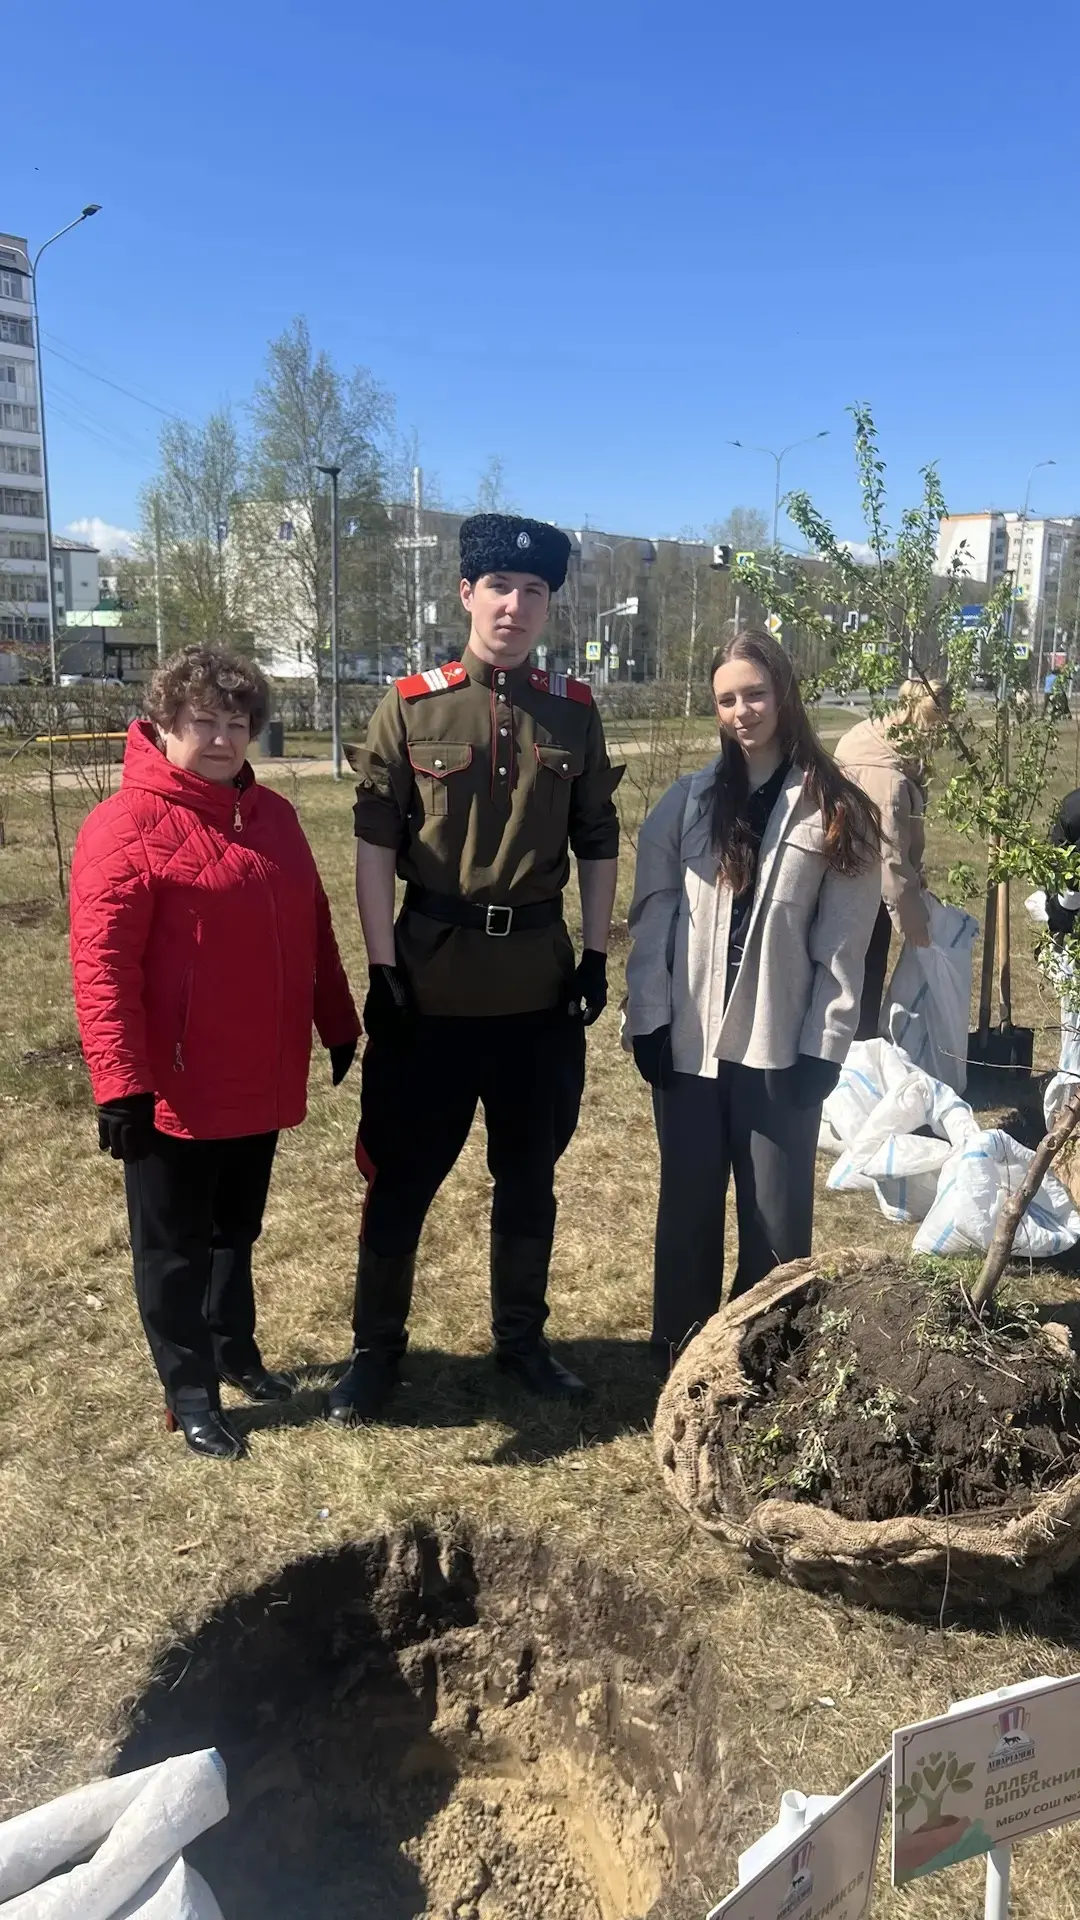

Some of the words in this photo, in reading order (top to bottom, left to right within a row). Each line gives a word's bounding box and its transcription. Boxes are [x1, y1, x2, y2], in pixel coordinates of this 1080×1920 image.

[985, 1769, 1039, 1798] АЛЛЕЯ
[996, 1808, 1031, 1828] МБОУ
[1033, 1798, 1061, 1814] СОШ
